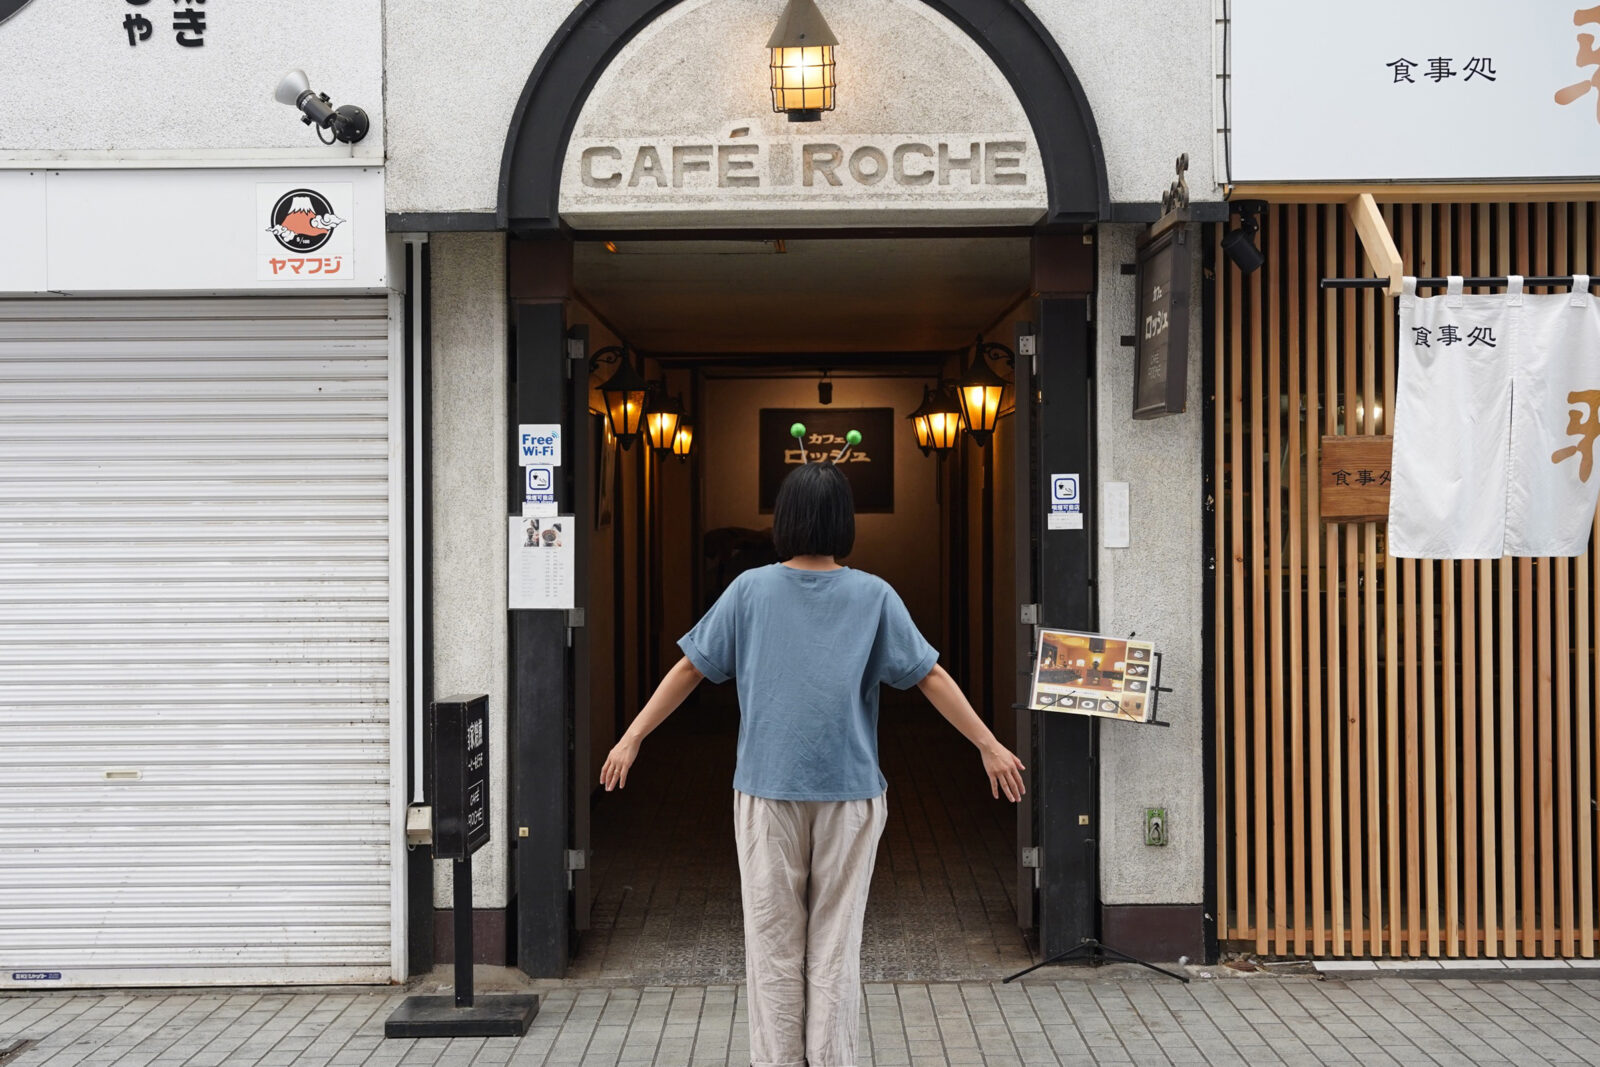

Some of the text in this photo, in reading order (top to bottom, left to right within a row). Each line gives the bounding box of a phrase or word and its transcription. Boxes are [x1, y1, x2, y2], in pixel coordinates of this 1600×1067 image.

[1386, 56, 1497, 84] 食事処
[580, 126, 1027, 188] CAFÉ ROCHE
[269, 256, 342, 275] ヤマフジ
[1411, 324, 1497, 348] 食事処
[522, 433, 554, 445] Free
[808, 433, 846, 444] カフェ
[523, 446, 554, 456] Wi-Fi
[784, 448, 871, 464] ロッシュ
